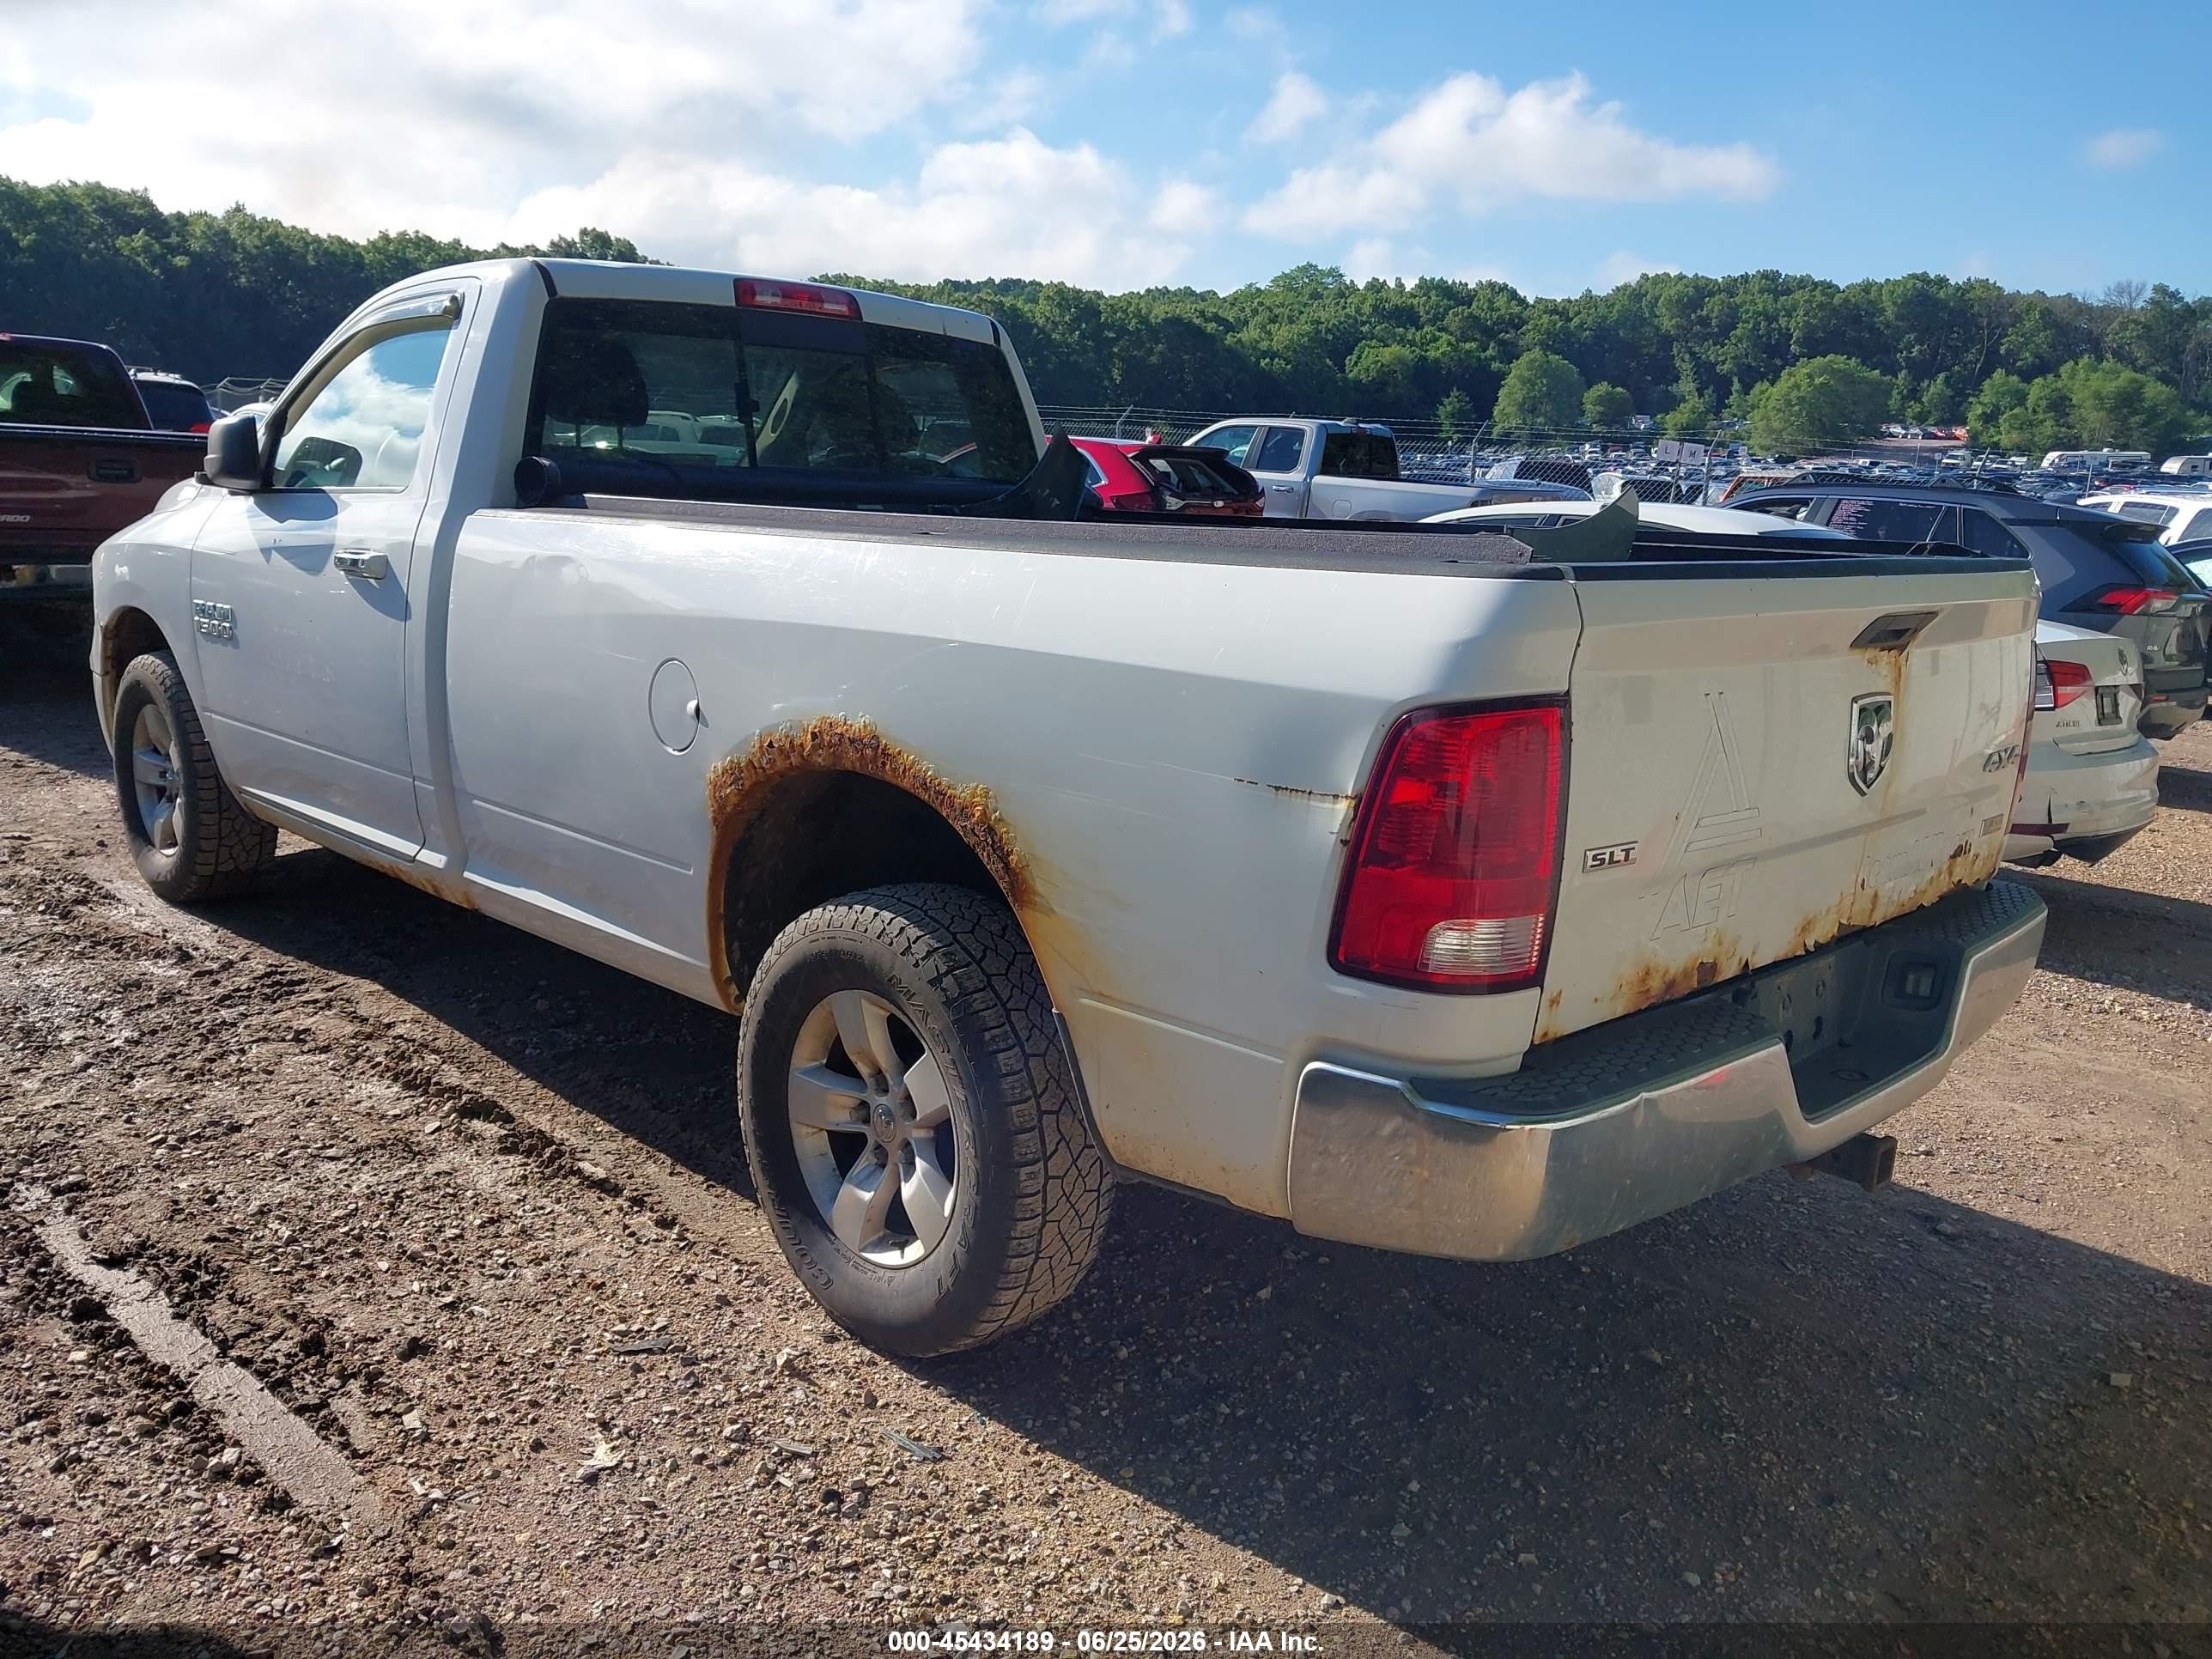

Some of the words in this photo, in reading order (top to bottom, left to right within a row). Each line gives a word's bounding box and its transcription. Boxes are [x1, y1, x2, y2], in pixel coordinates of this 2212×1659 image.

[192, 599, 231, 622] RAM
[193, 617, 234, 640] 1500
[1589, 847, 1636, 869] SLT
